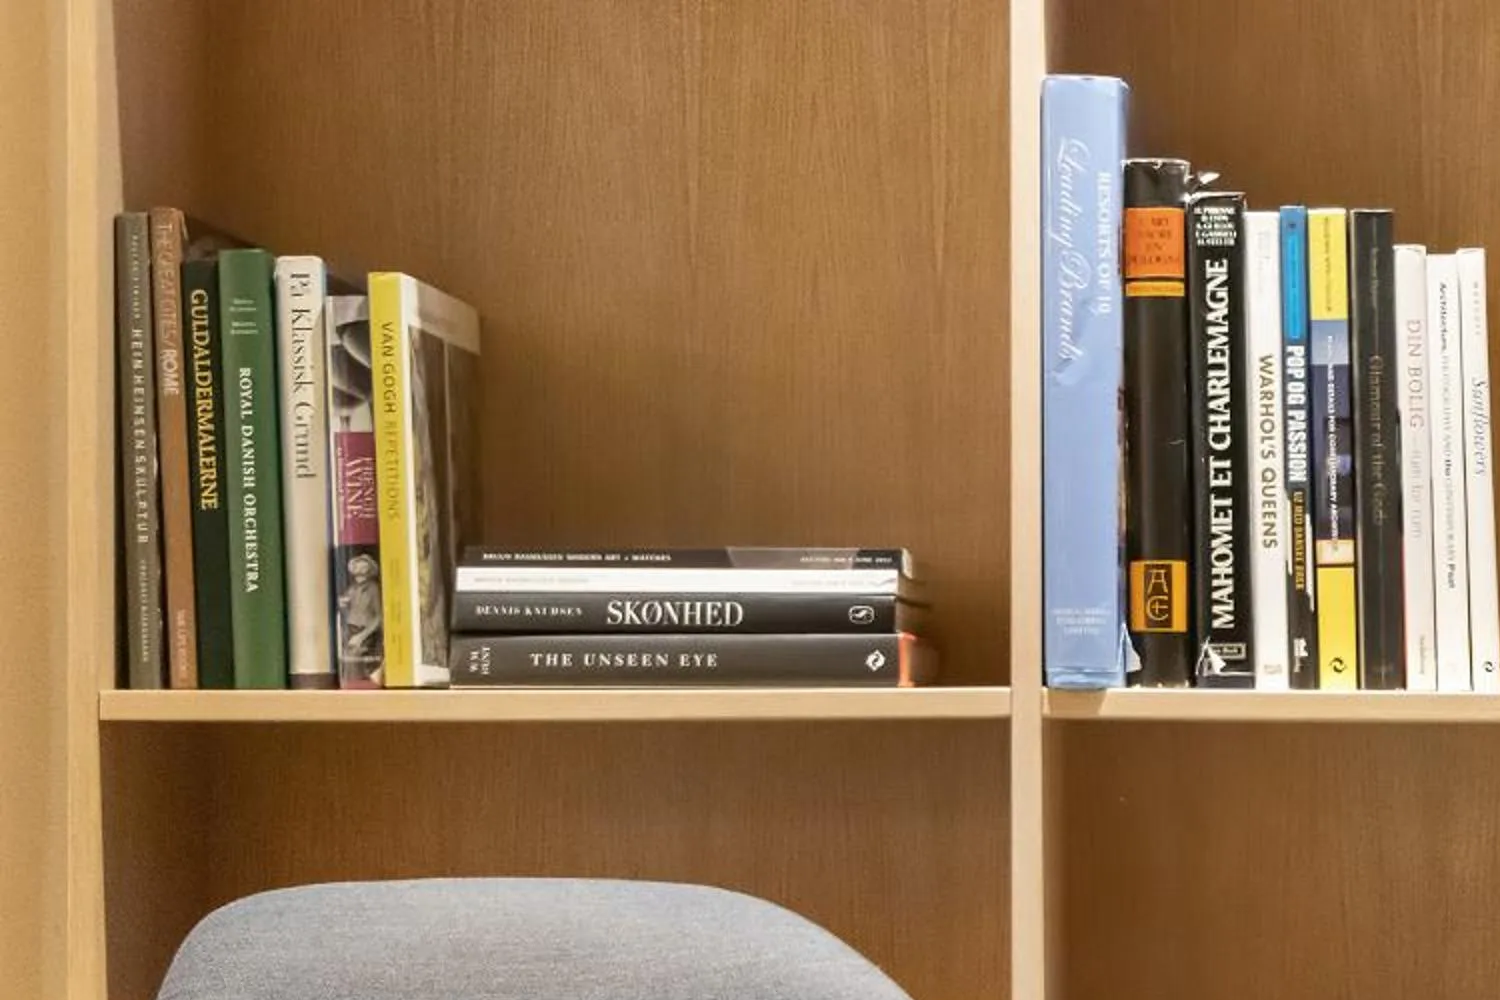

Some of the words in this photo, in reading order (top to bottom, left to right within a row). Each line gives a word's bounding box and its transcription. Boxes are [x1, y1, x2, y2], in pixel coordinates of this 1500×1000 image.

[1096, 171, 1112, 258] RESORTS
[1098, 262, 1112, 291] OF
[291, 308, 314, 394] Klassisk
[381, 321, 396, 357] VAN
[1204, 258, 1233, 448] CHARLEMAGNE
[1286, 344, 1304, 379] POP
[1406, 319, 1421, 358] DIN
[190, 288, 218, 510] GULDALDERMALERNE
[239, 366, 252, 419] ROYAL
[383, 363, 398, 413] GOGH
[1259, 354, 1278, 460] WARHOL'S
[1287, 382, 1305, 406] OG
[1408, 366, 1424, 429] BOLIG
[241, 424, 256, 491] DANISH
[294, 401, 317, 479] Grund
[1287, 410, 1308, 483] PASSION
[1470, 376, 1490, 476] Sunflowers
[1210, 457, 1234, 487] ET
[1261, 468, 1279, 550] QUEENS
[245, 496, 259, 593] ORCHESTRA
[1211, 494, 1235, 630] MAHOMET
[606, 600, 745, 628] SKØNHED
[530, 652, 574, 668] THE
[583, 652, 670, 668] UNSEEN
[679, 652, 719, 668] EYE
